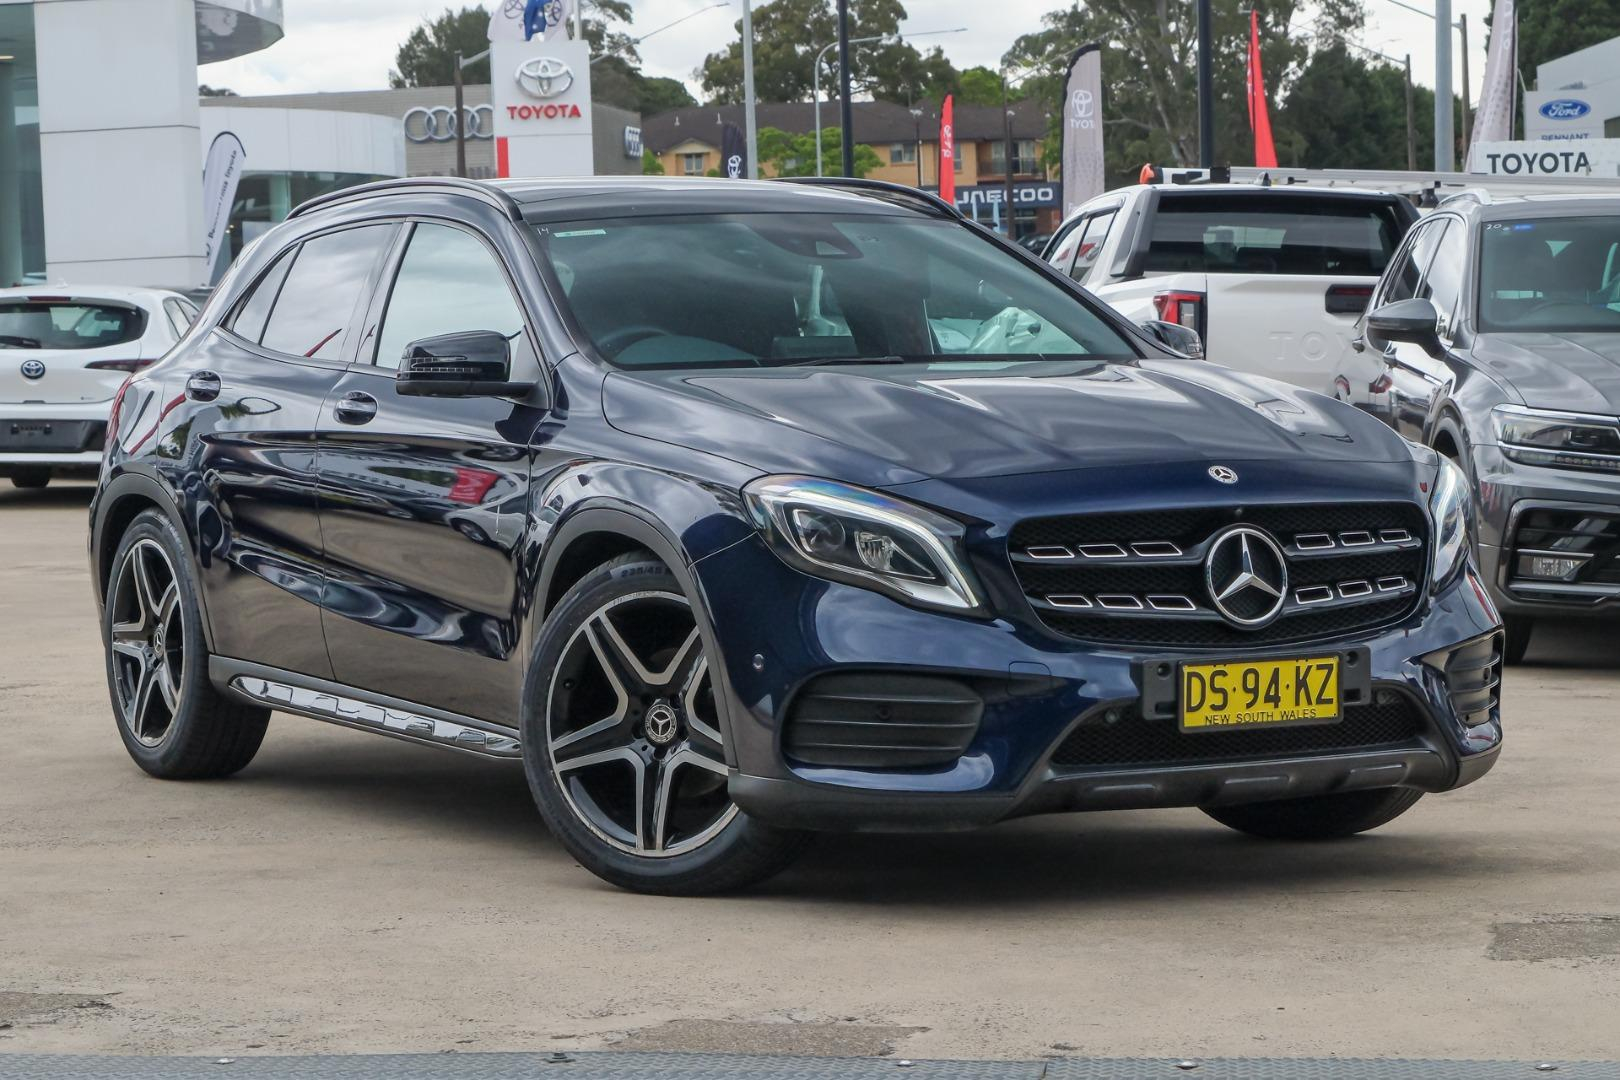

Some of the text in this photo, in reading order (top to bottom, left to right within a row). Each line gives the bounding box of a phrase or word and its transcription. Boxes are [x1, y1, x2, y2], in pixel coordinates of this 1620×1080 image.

[507, 104, 581, 120] TOYOTA
[1548, 103, 1581, 116] Ford
[1486, 152, 1592, 175] TOYOTA
[958, 187, 1053, 204] JAECOO
[1205, 708, 1317, 726] NEW SOUTH WALES
